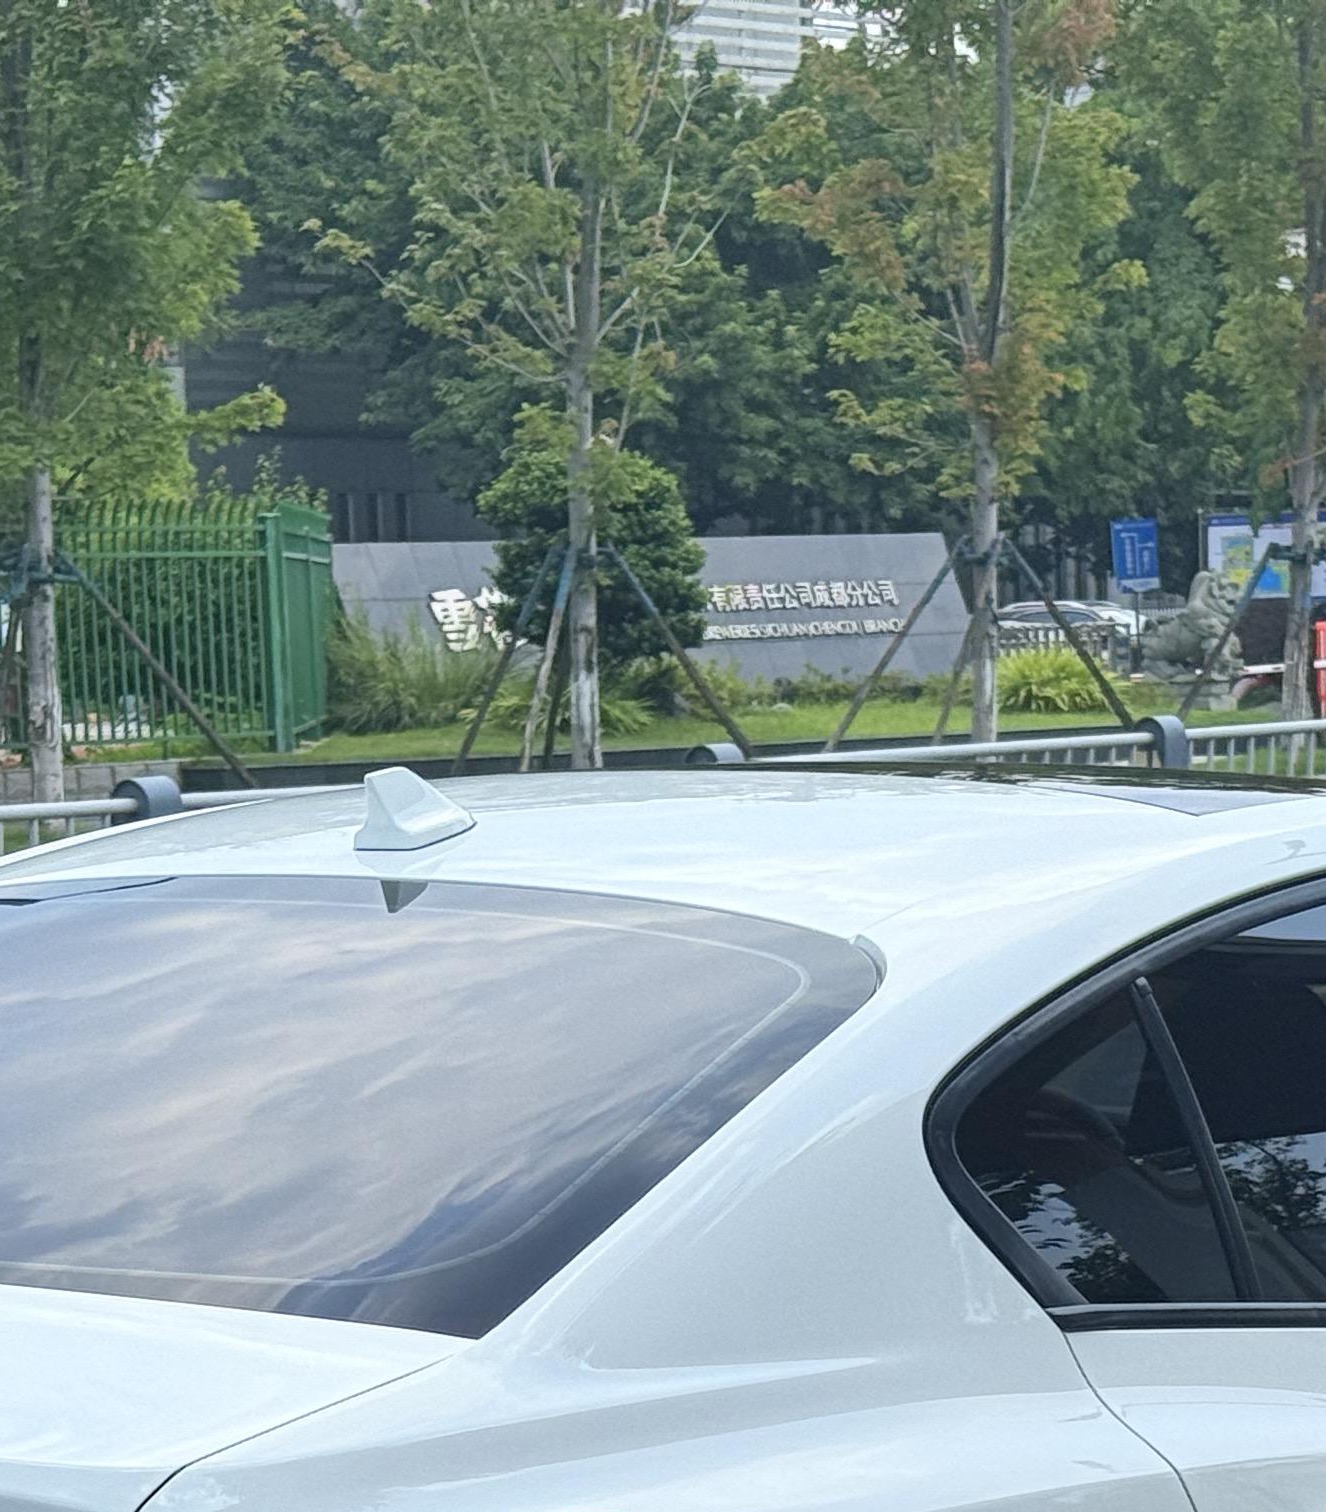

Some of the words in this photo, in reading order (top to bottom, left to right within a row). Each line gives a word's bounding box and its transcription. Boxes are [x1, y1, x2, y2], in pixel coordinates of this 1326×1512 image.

[706, 579, 899, 612] 有限责任公司成都分公司
